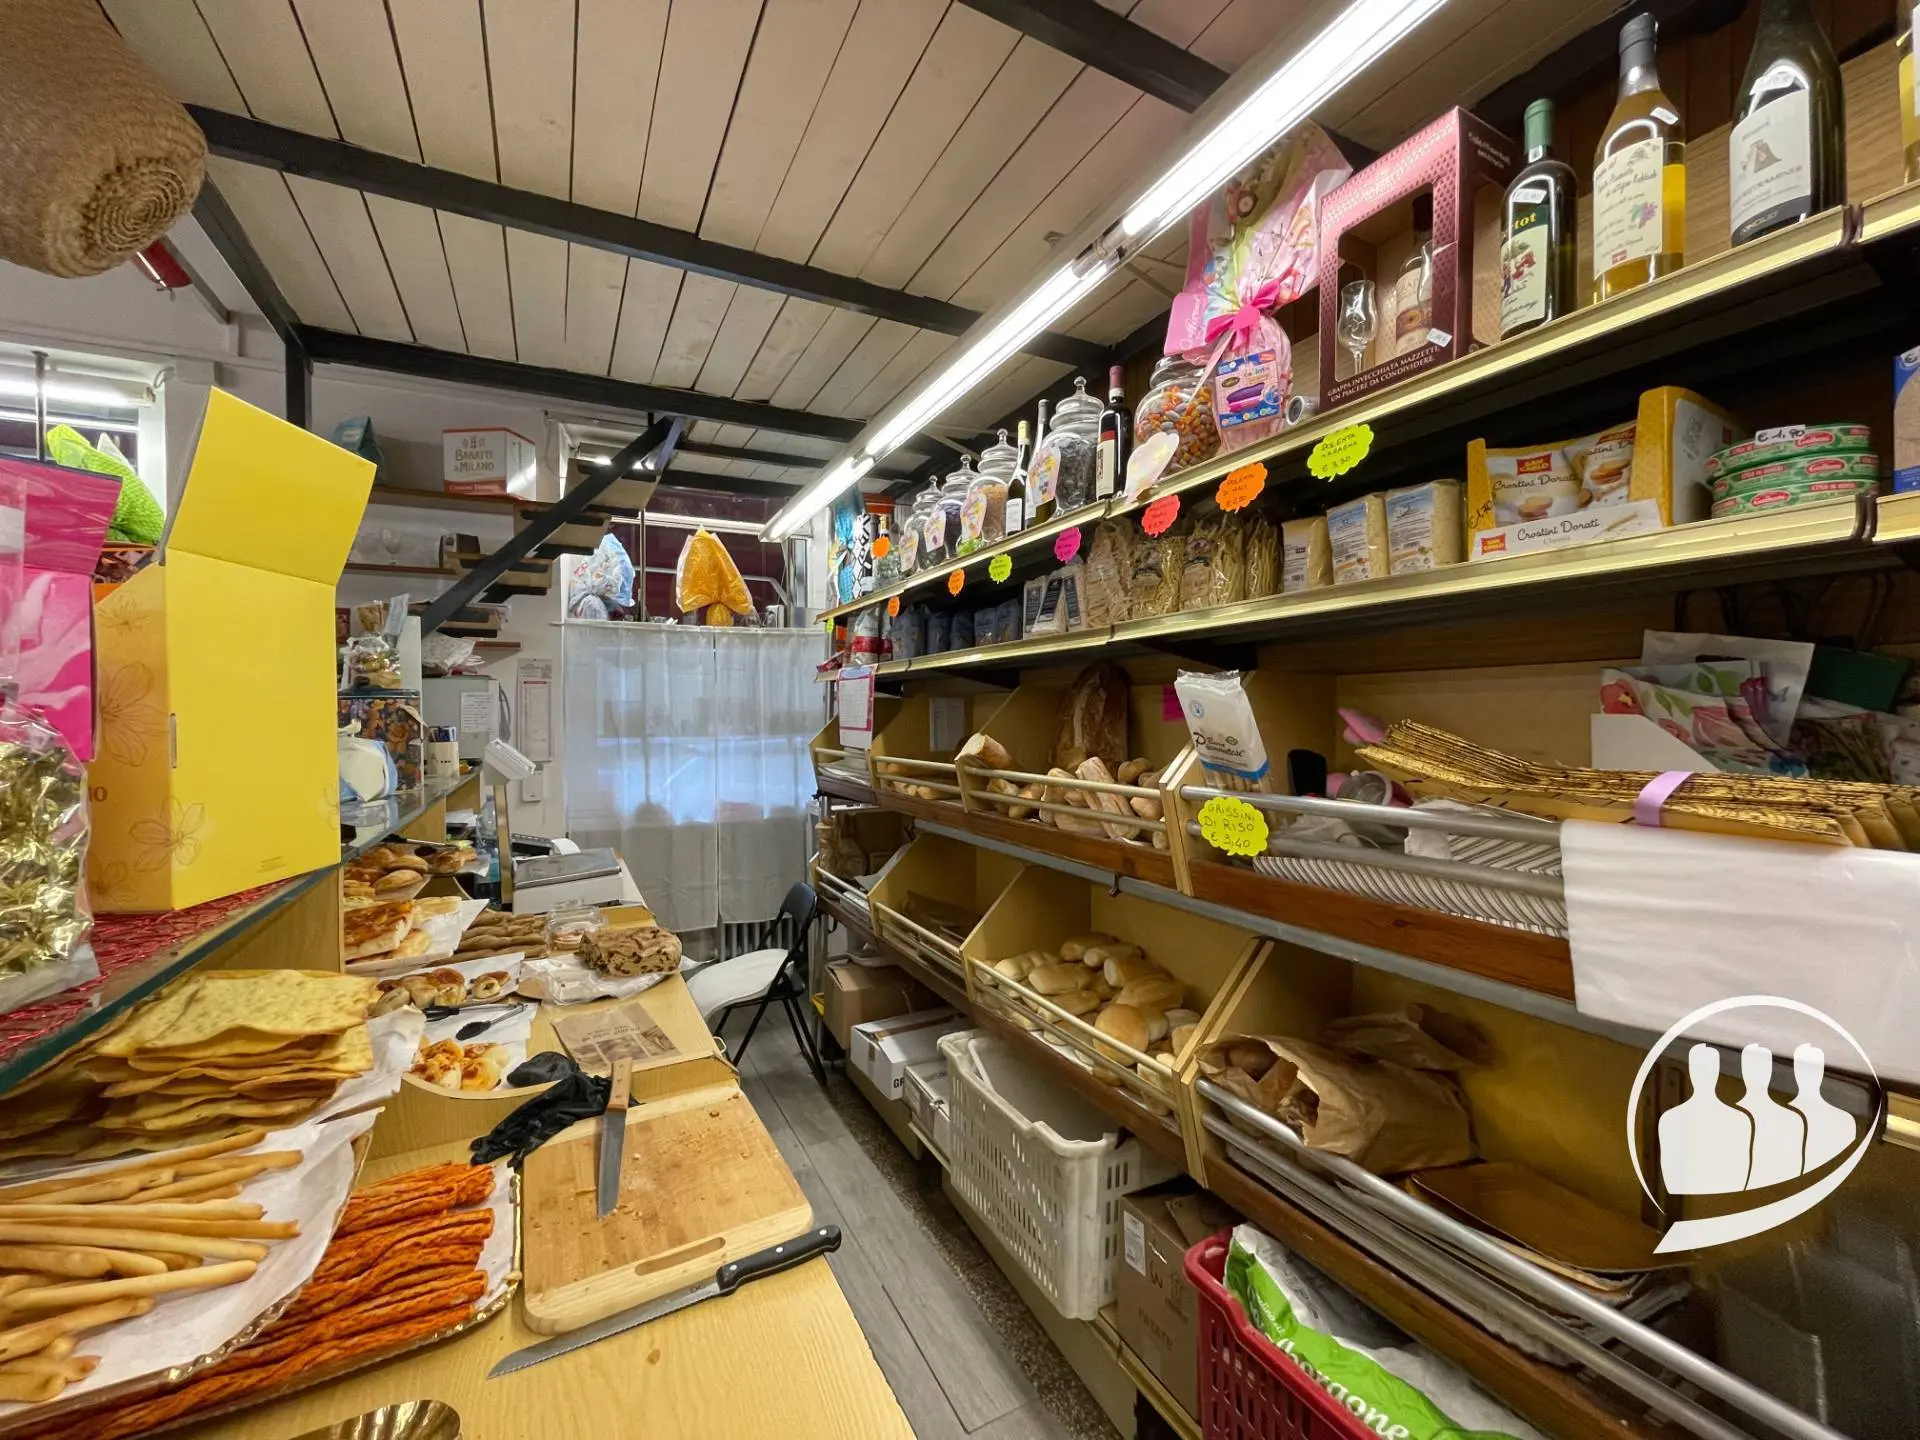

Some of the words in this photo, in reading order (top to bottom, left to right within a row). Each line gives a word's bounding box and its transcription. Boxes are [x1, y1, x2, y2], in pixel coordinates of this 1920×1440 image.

[459, 461, 495, 473] MILANO
[1492, 479, 1536, 492] Crostini
[1517, 526, 1560, 541] Crostini
[1560, 518, 1600, 533] Dorati
[1207, 803, 1256, 822] GRISSINI
[1204, 815, 1217, 828] DI
[1223, 818, 1254, 833] RISO
[1223, 833, 1251, 849] 3,40
